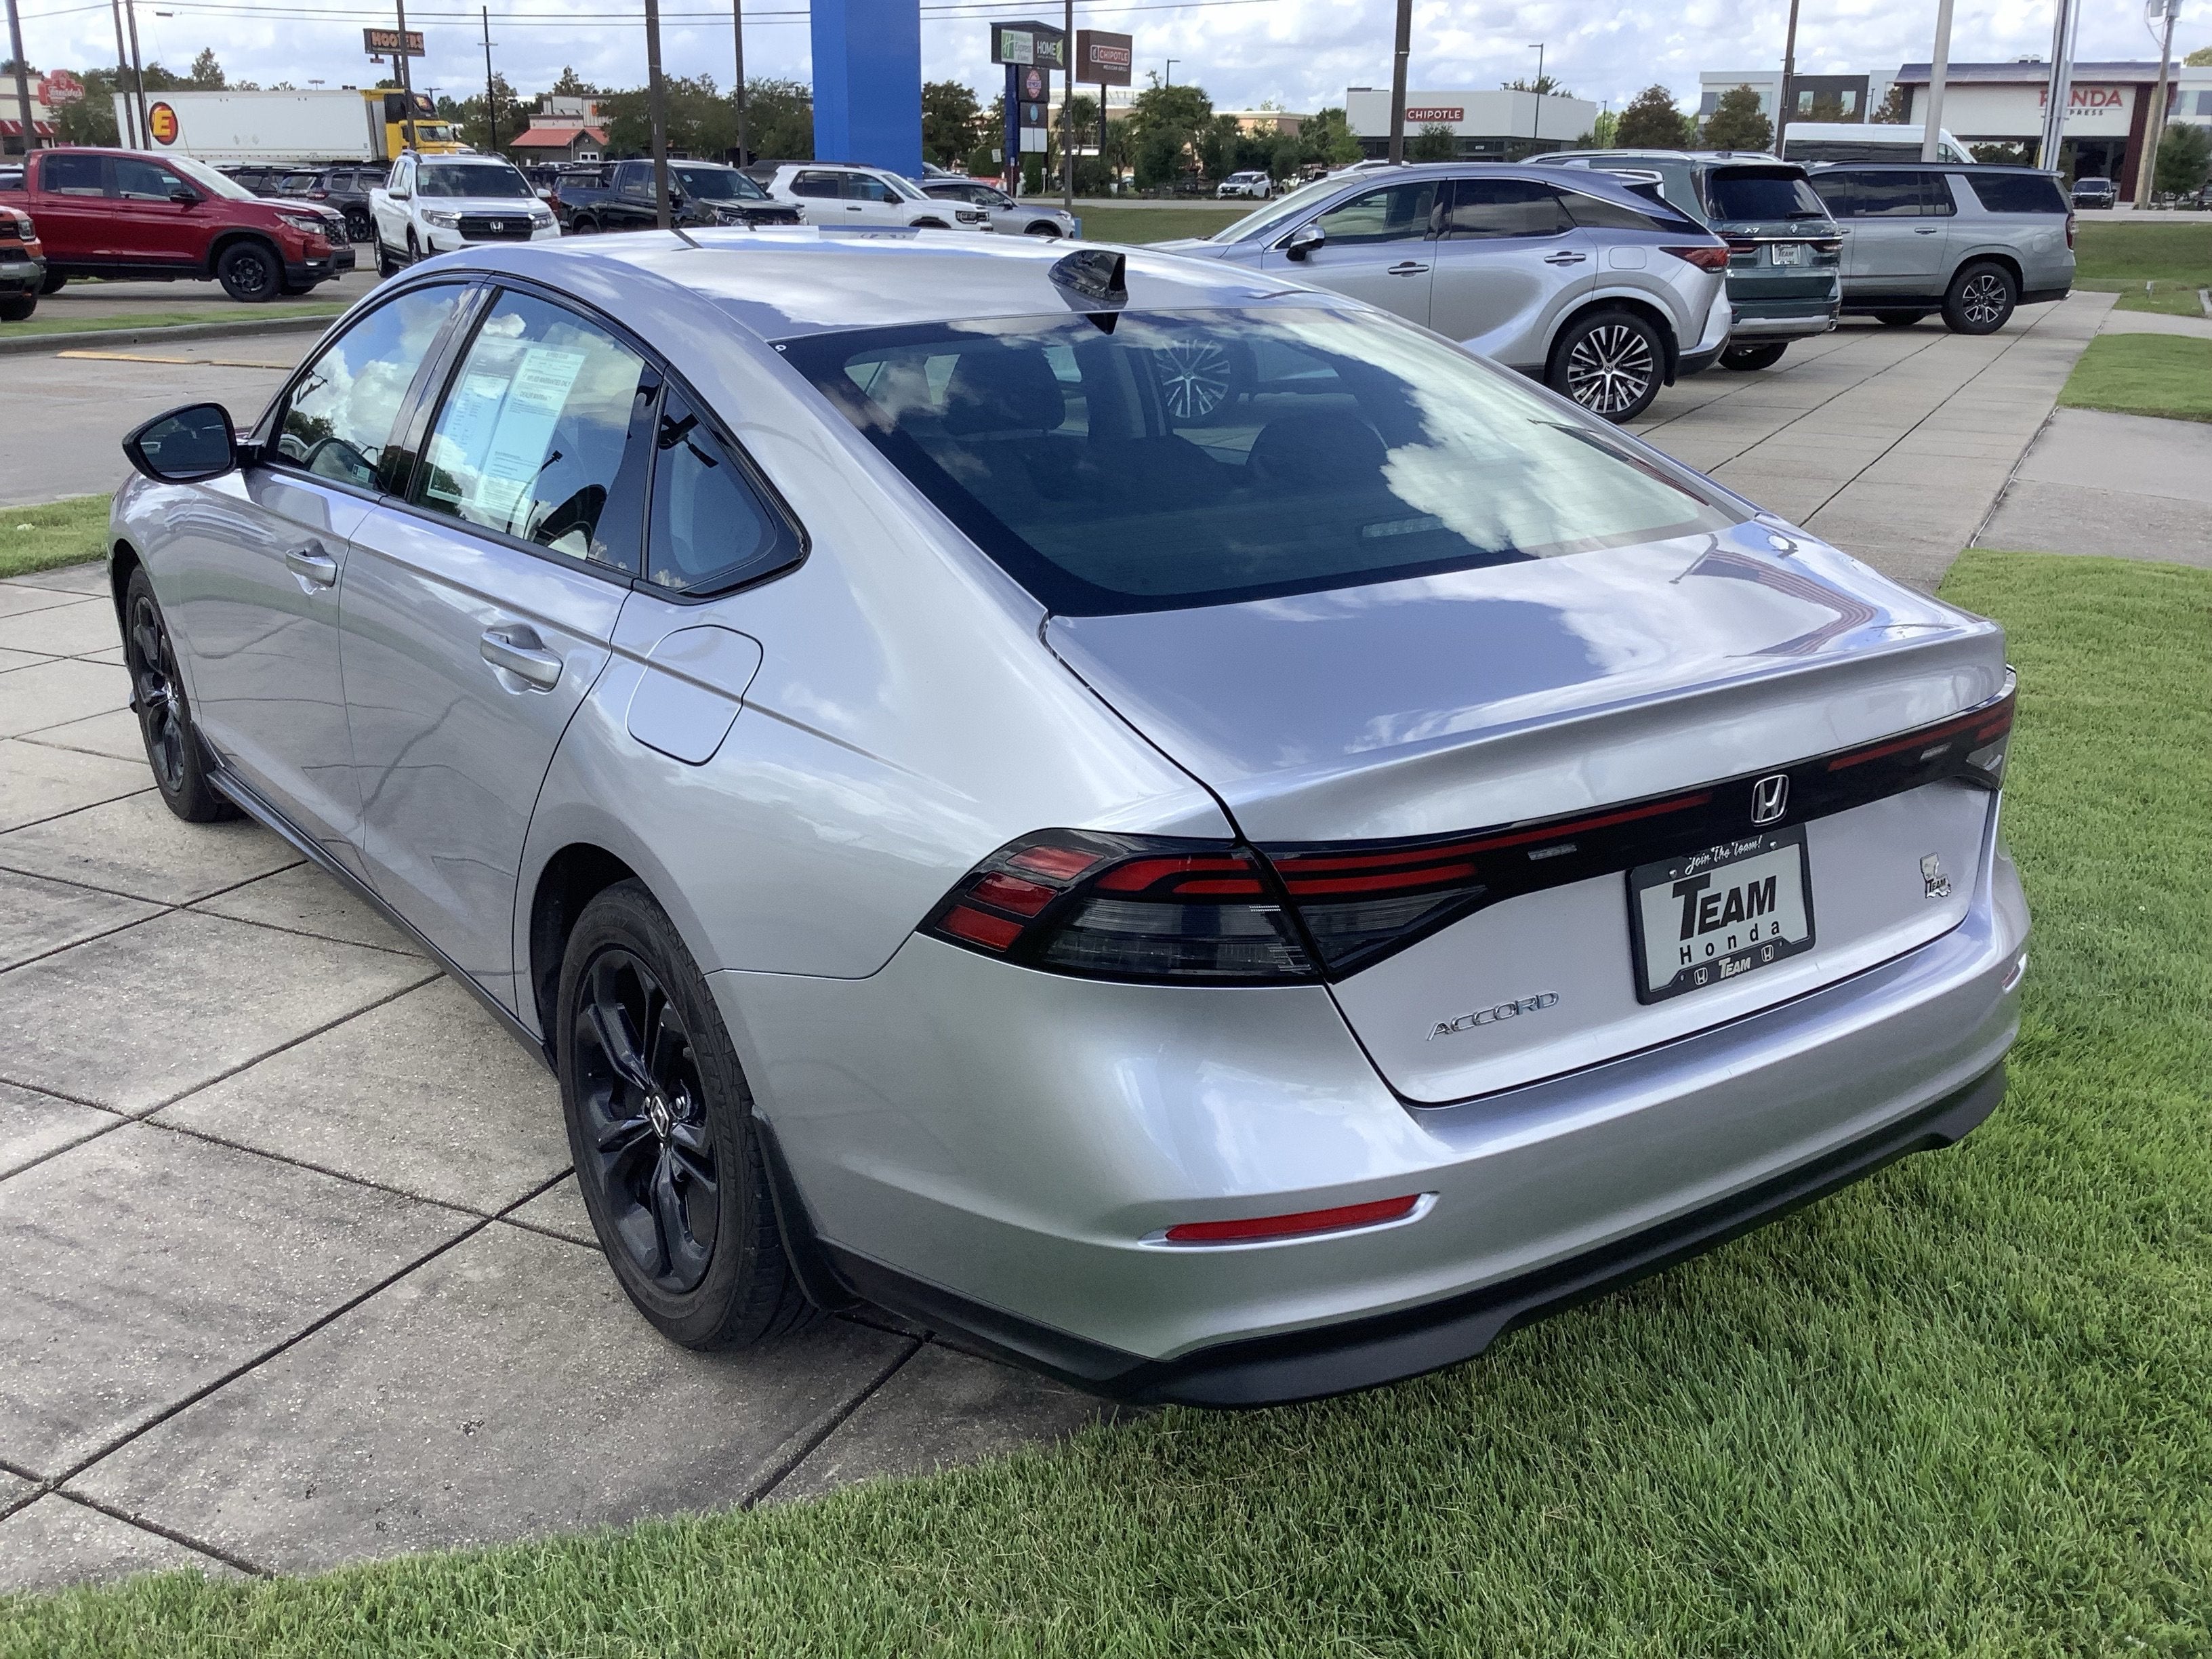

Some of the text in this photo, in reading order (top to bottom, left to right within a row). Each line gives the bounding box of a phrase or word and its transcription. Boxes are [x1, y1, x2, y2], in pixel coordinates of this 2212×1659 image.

[1037, 41, 1056, 56] HOME
[1099, 49, 1128, 62] CHIPOTLE
[2039, 89, 2123, 107] PNDA
[152, 110, 173, 137] E
[1408, 110, 1461, 119] CHIPOTLE
[1778, 247, 1795, 257] TEAM
[1685, 834, 1763, 876] Join The Team!
[1925, 878, 1946, 893] TEAM
[1672, 872, 1777, 941] TEAM
[1679, 920, 1780, 965] Honda
[1718, 956, 1752, 979] TEAM
[1426, 990, 1559, 1042] ACCORD
